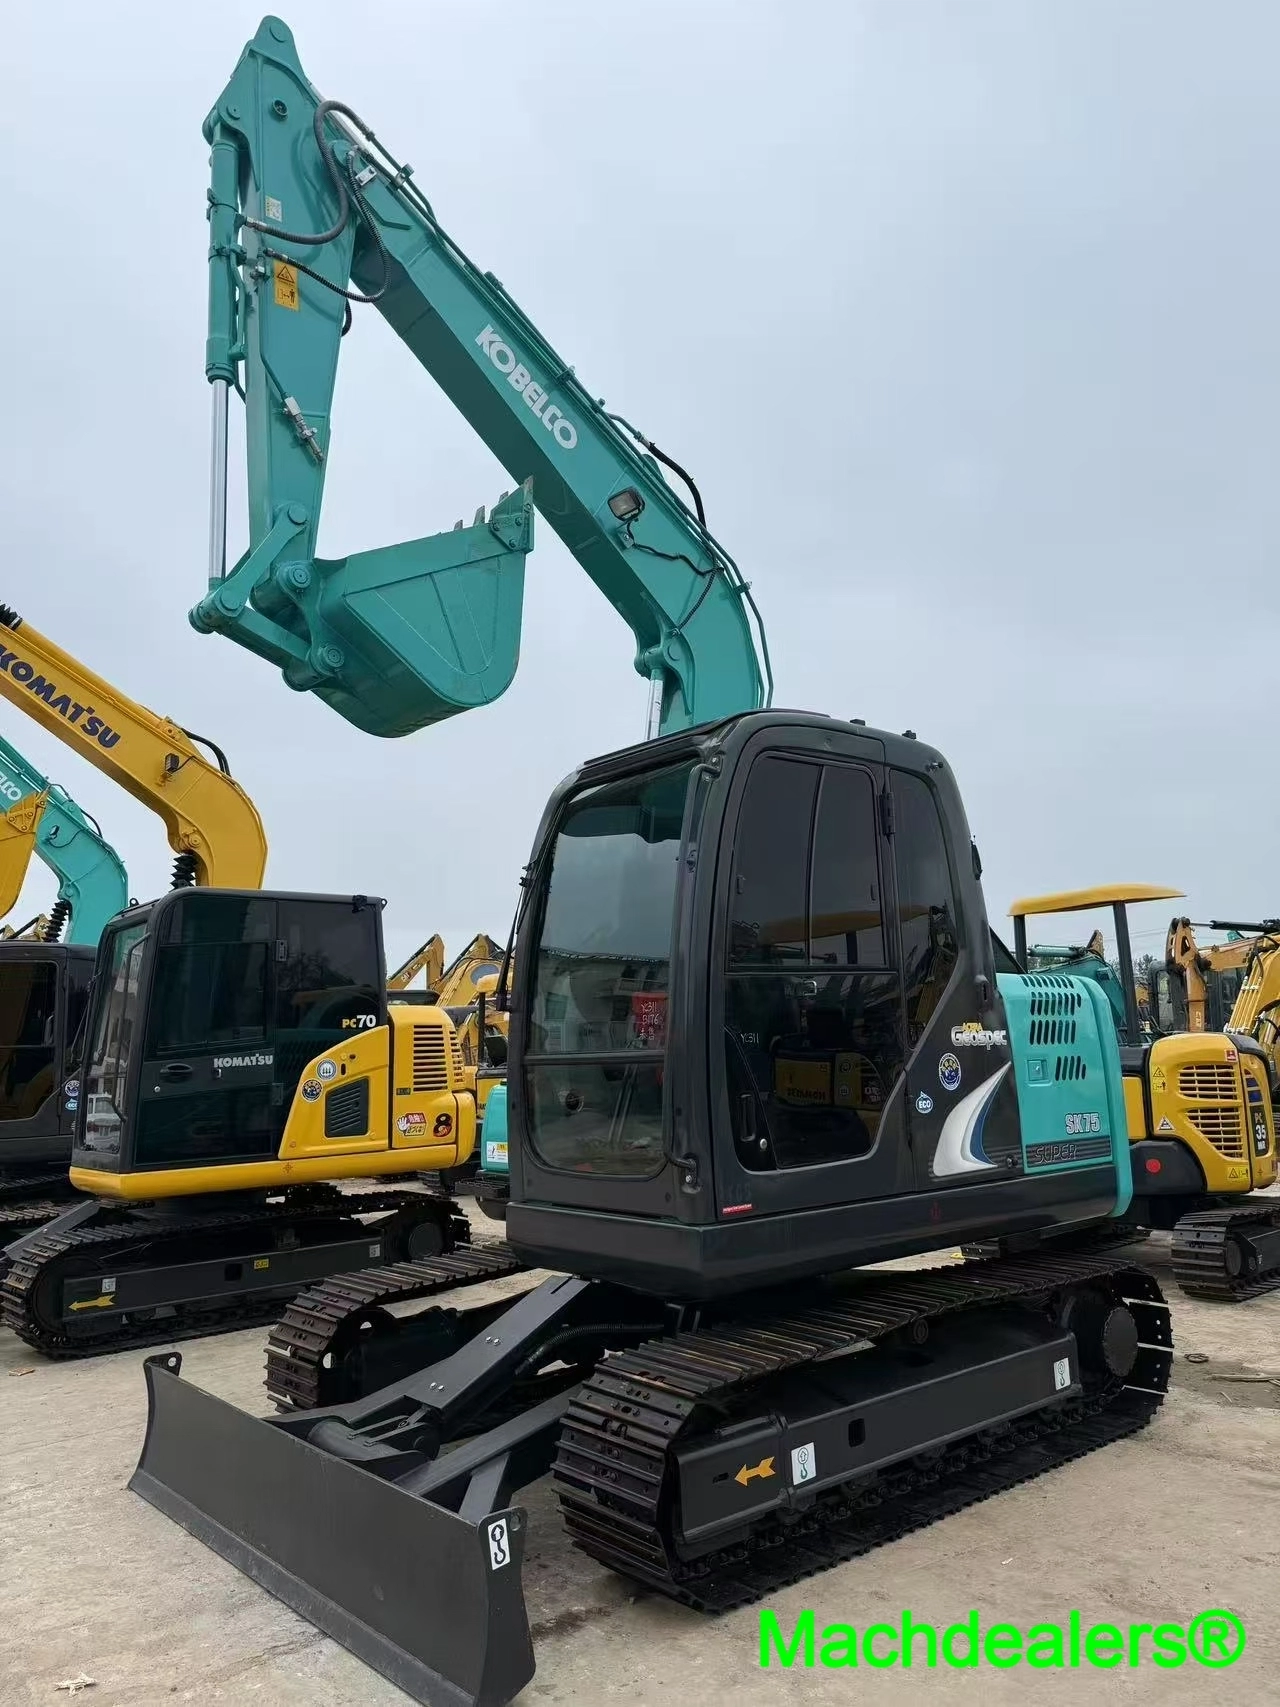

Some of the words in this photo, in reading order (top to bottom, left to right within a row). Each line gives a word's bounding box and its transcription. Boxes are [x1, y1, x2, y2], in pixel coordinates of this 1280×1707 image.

[474, 323, 578, 450] KOBELCO
[0, 643, 122, 749] KOMATSU
[213, 1053, 274, 1068] KOMATSU
[918, 1100, 931, 1109] ECO
[1255, 1124, 1266, 1140] 35
